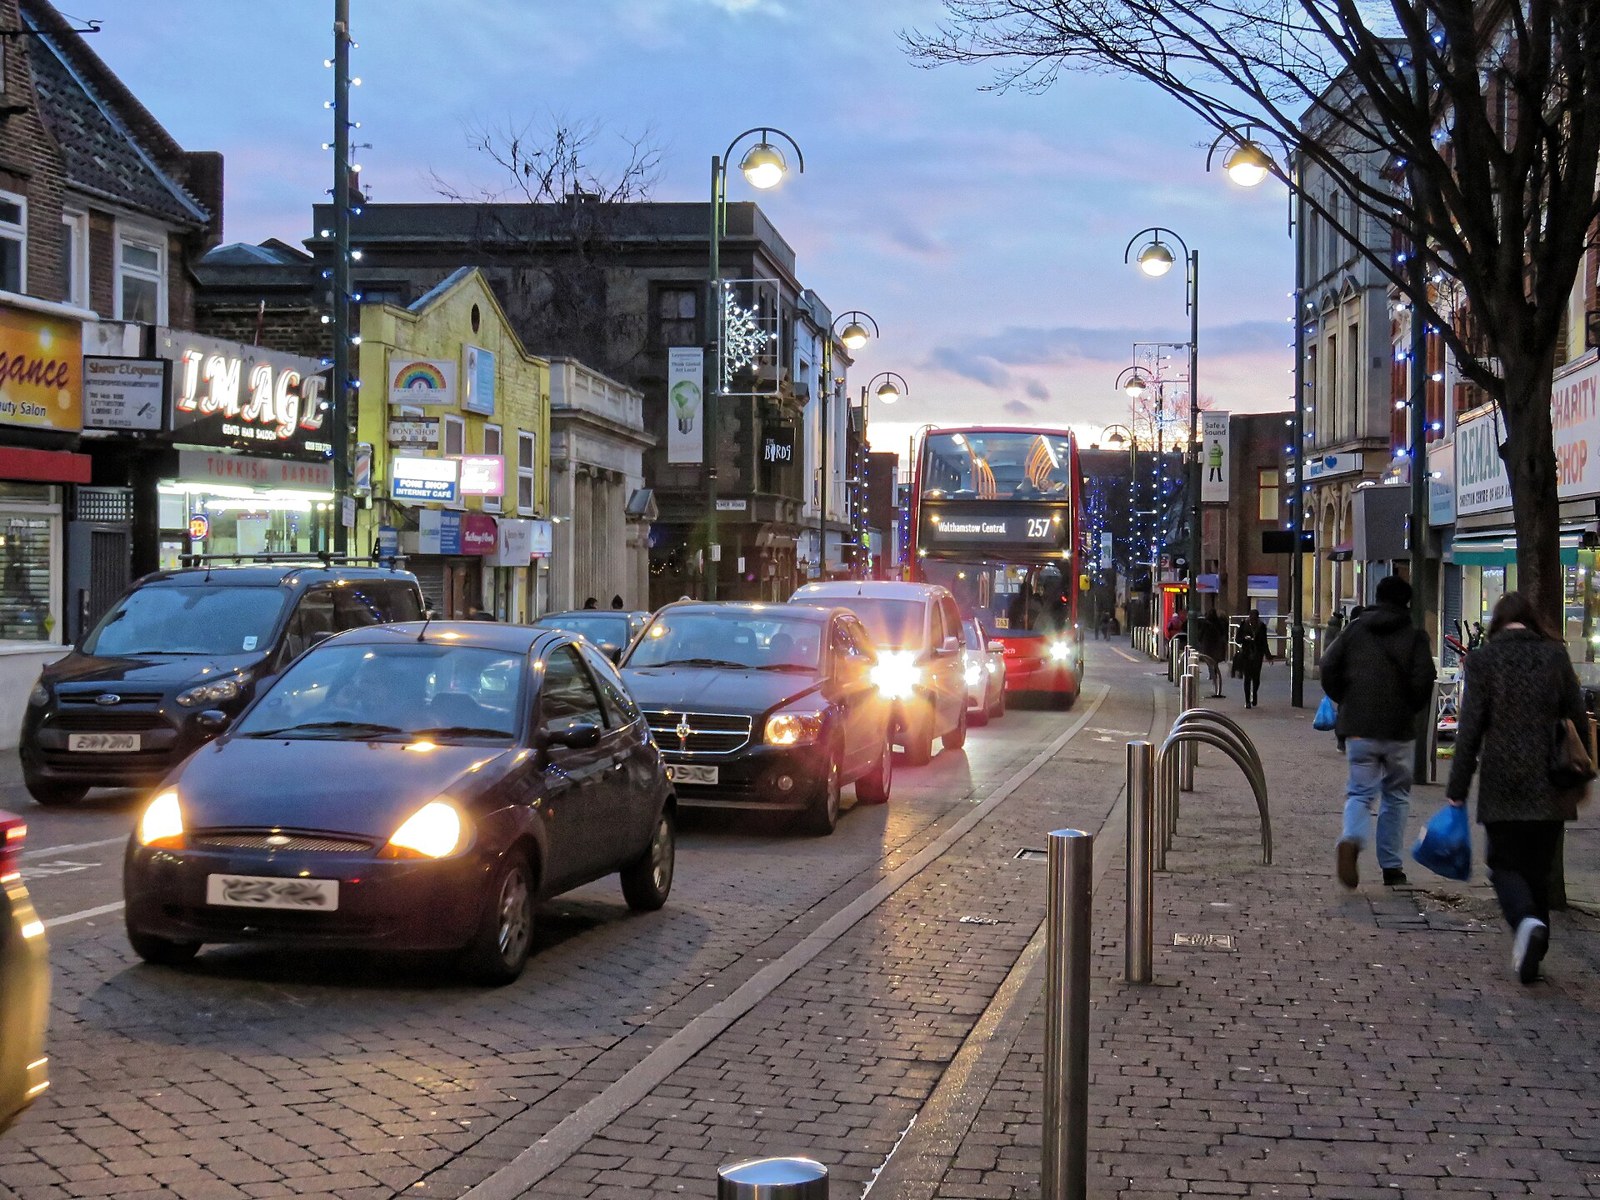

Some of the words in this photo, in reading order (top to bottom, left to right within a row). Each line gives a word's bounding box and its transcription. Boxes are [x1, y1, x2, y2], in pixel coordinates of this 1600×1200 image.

[176, 349, 327, 440] IMAGE
[20, 402, 46, 417] Salon
[222, 424, 240, 436] GENTS
[241, 426, 255, 438] HAIR
[255, 428, 277, 441] SALOON
[415, 428, 437, 436] SHOP
[207, 457, 269, 480] TURKISH
[281, 463, 329, 484] BARBER
[1556, 439, 1587, 485] SHOP
[395, 488, 432, 497] INTERNET
[432, 490, 452, 499] CAFÉ
[424, 480, 449, 490] SHOP
[938, 522, 980, 533] Walthamstow
[982, 522, 1006, 533] Central
[1027, 518, 1050, 537] 257
